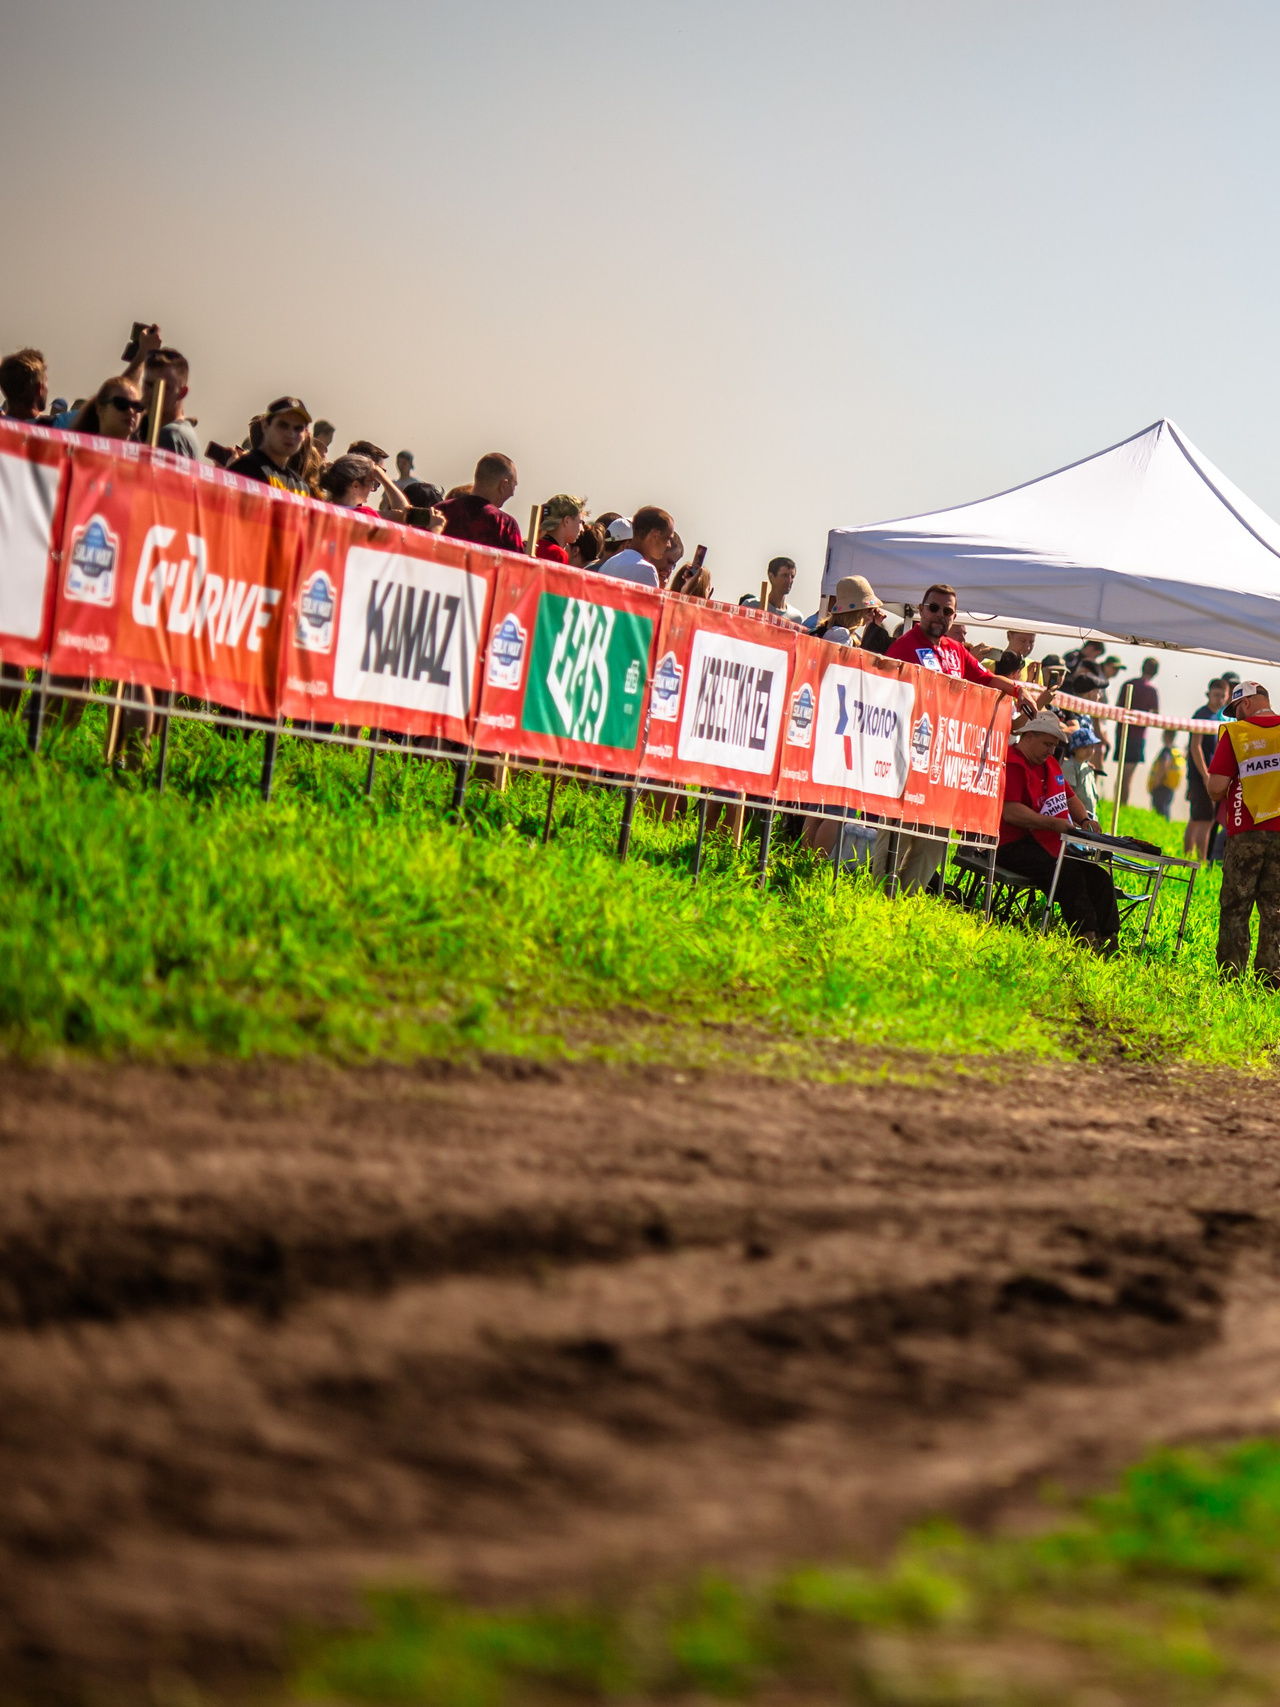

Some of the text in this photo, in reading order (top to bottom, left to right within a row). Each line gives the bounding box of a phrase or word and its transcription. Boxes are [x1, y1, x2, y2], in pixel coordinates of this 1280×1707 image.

[74, 545, 112, 566] SILK WAY
[361, 579, 461, 687] KAMAZ
[493, 639, 521, 657] SILK WAY
[853, 700, 897, 740] ТРИКОЛОР
[947, 718, 967, 755] SILK
[980, 727, 1005, 762] RALLY
[874, 760, 891, 778] СПОРТ
[944, 755, 962, 789] WAY
